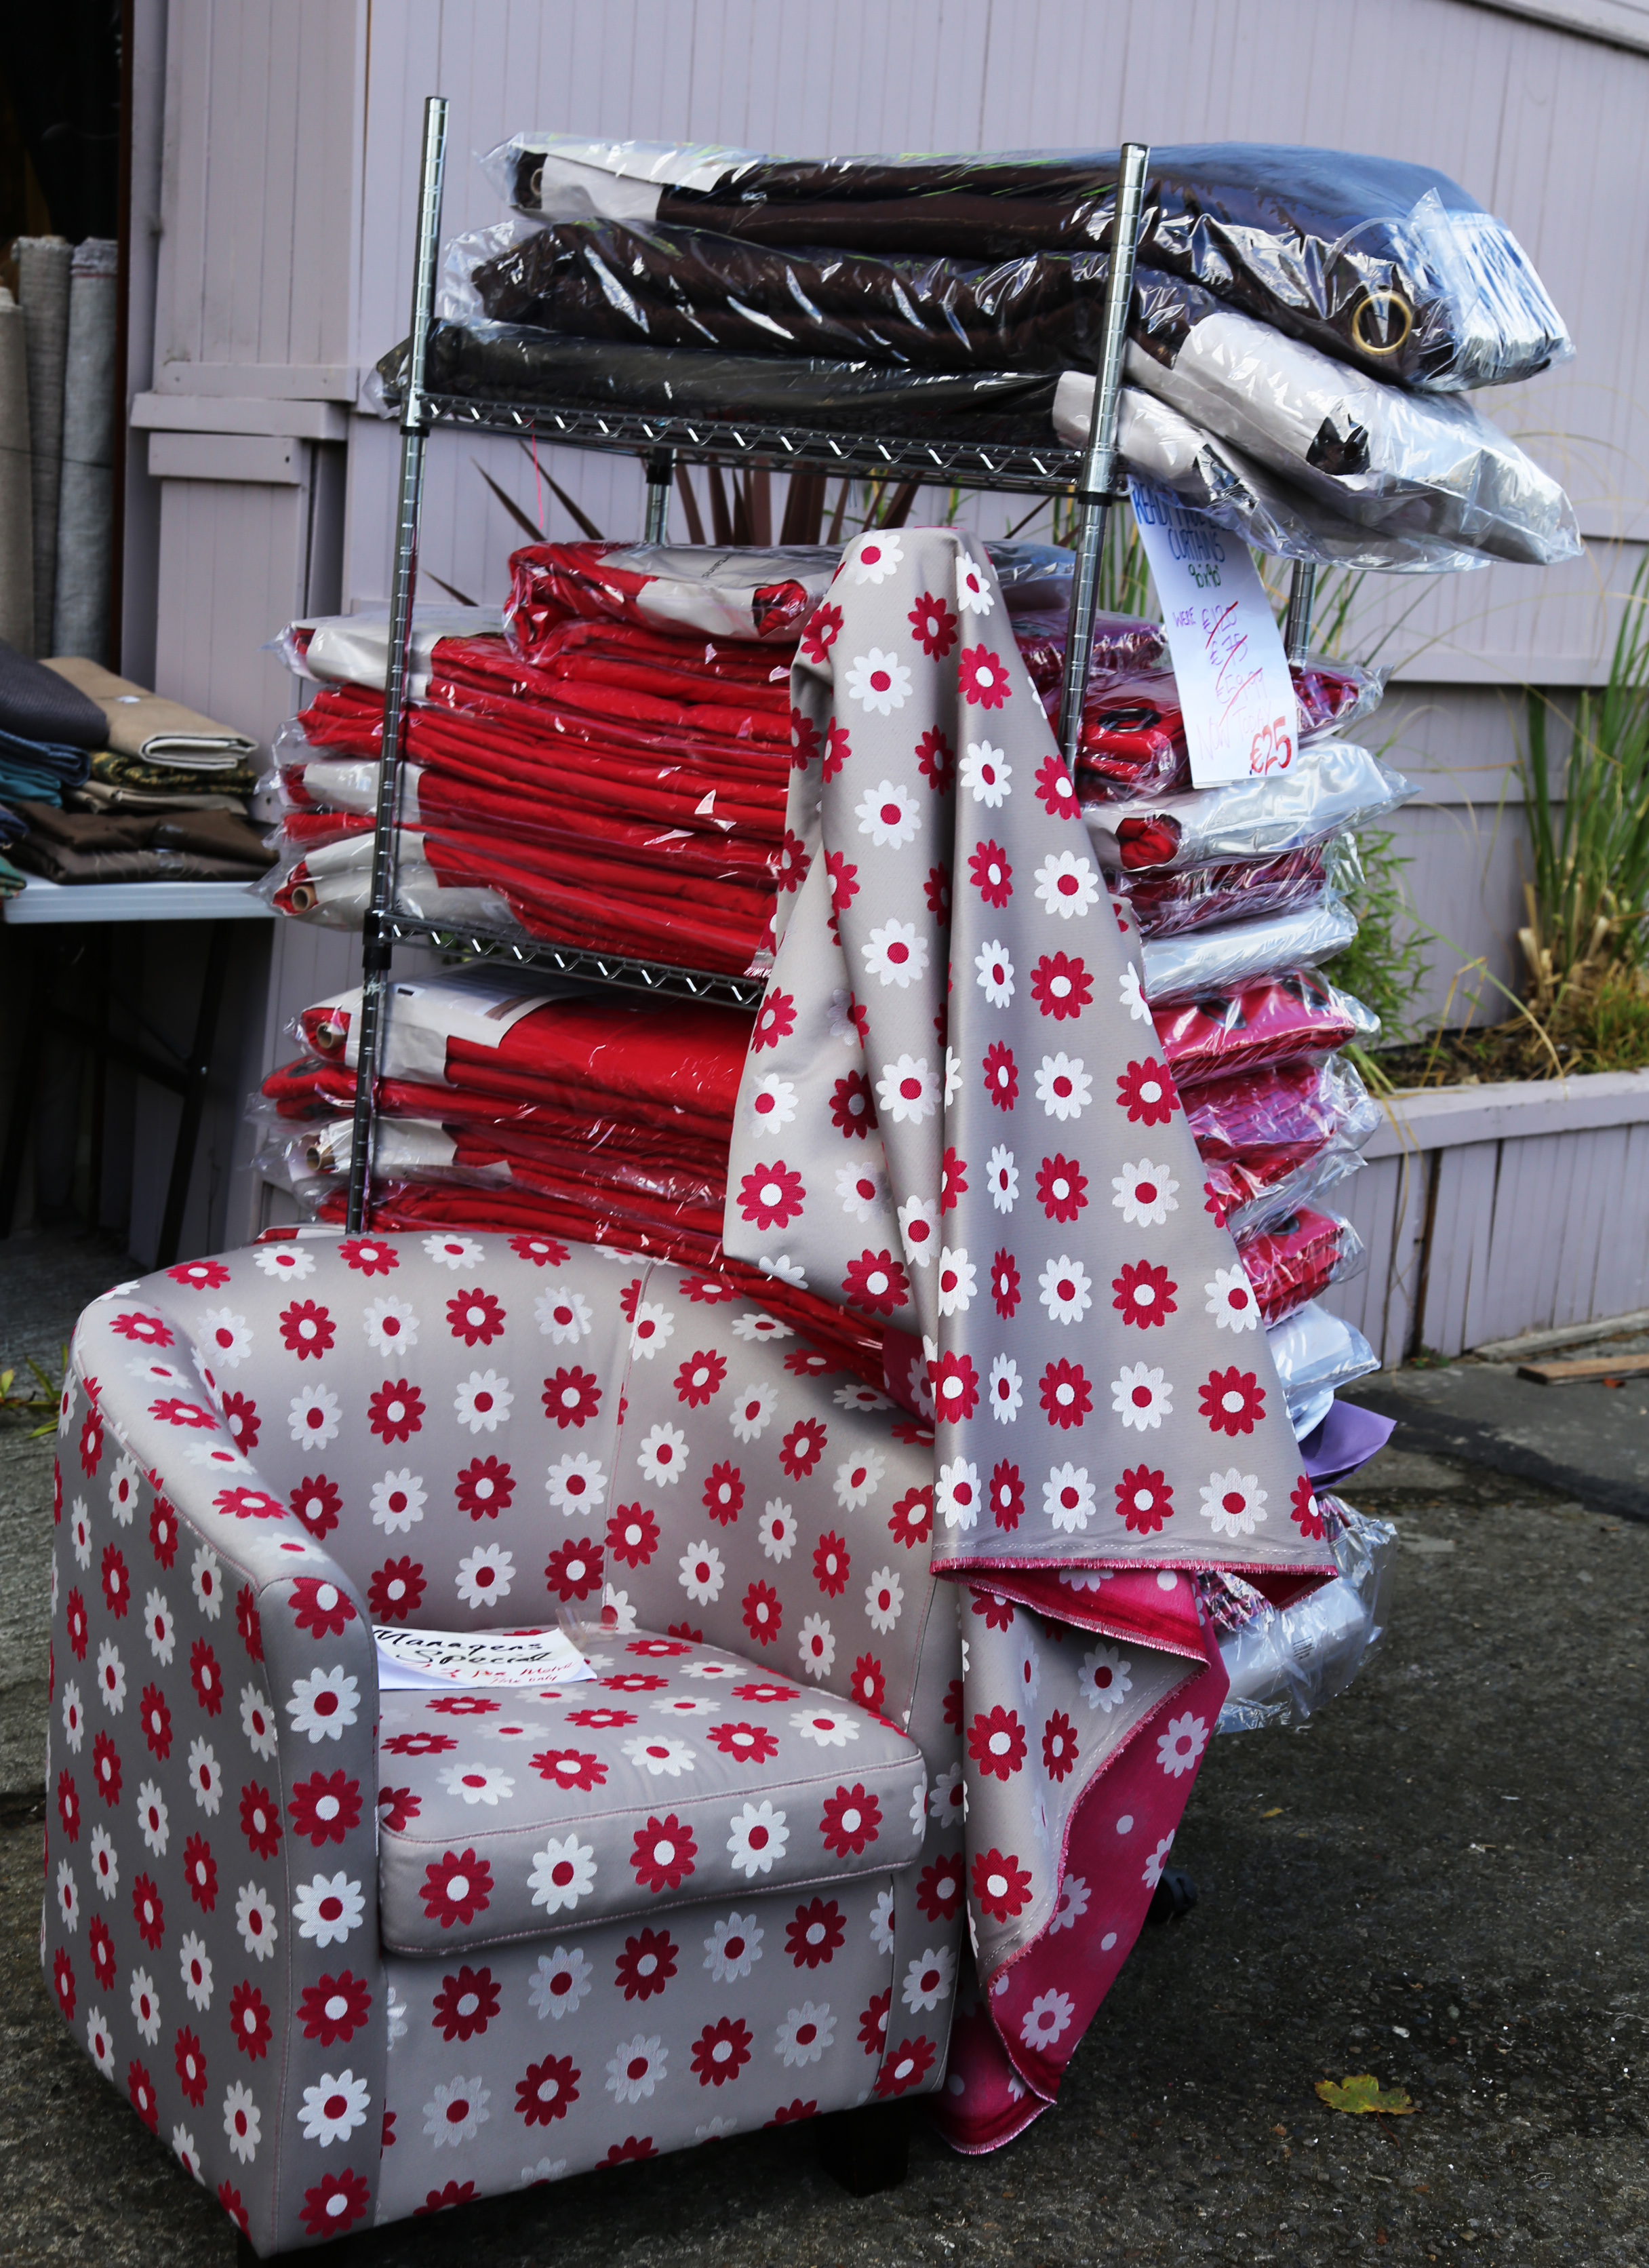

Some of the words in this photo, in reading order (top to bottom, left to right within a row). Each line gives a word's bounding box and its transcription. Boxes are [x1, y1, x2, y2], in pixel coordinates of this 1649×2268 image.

[1168, 528, 1226, 563] CURTAINS
[1172, 606, 1196, 628] WERE
[1196, 714, 1230, 760] NOW
[396, 1649, 555, 1665] Special
